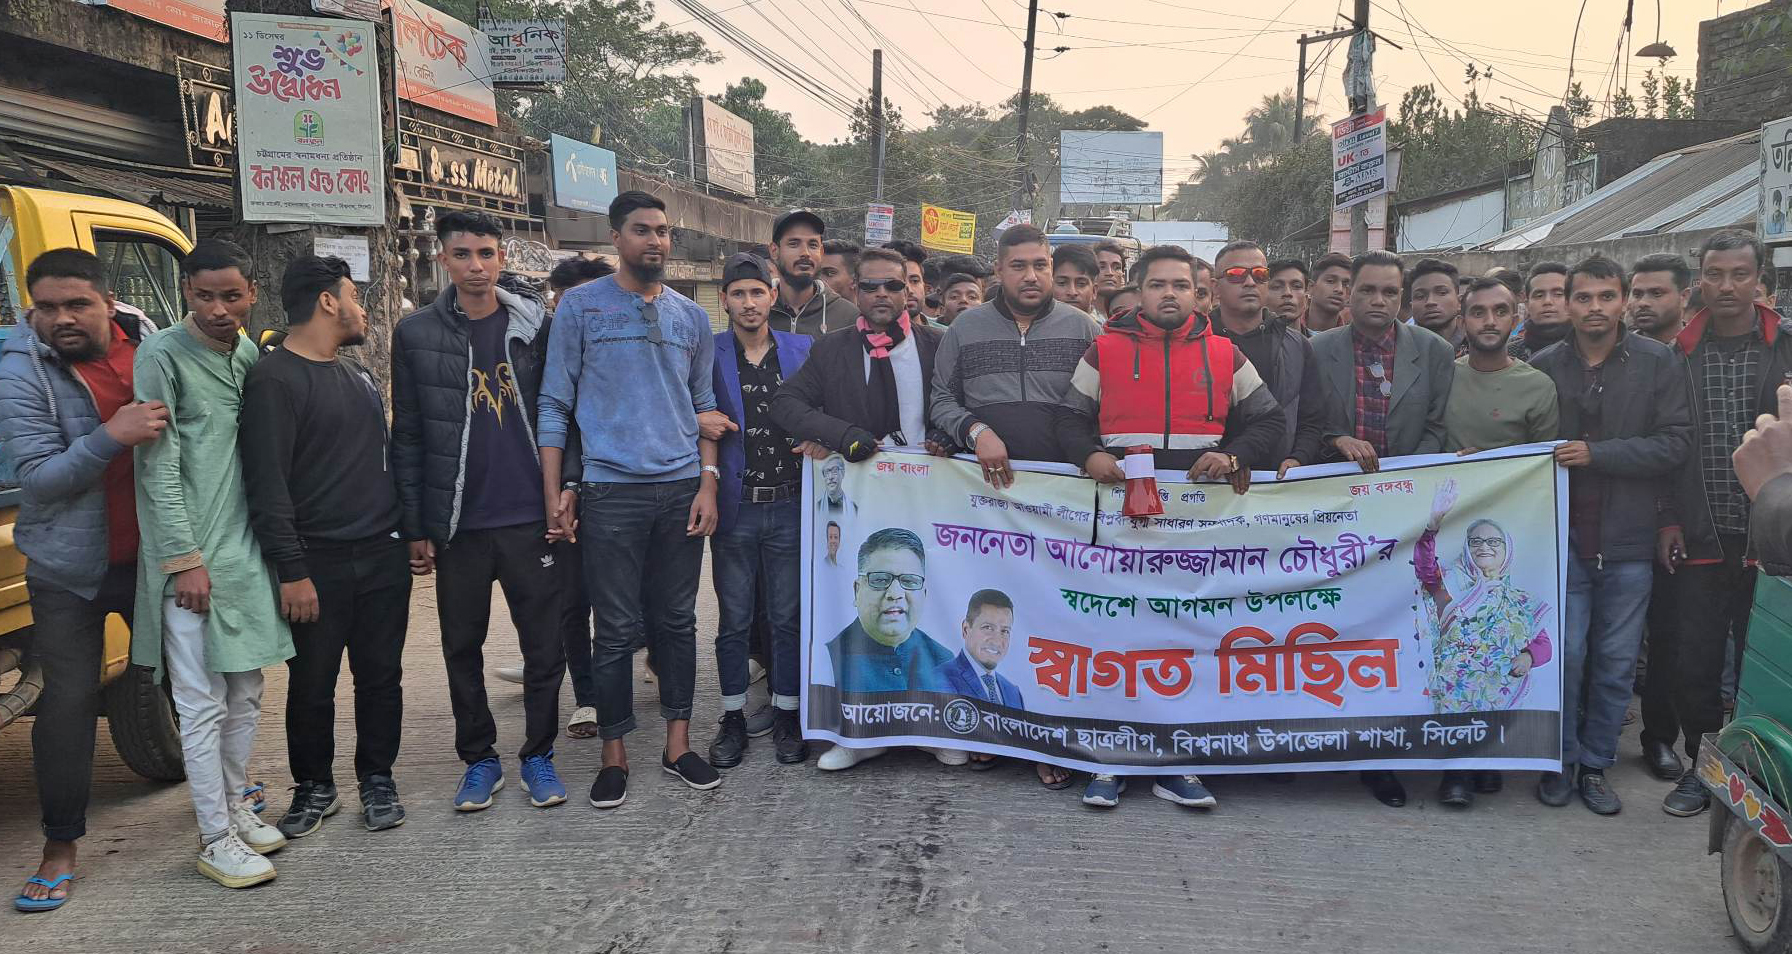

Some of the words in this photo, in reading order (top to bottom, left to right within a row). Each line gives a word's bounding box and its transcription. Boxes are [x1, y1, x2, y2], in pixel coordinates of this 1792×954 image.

[488, 26, 560, 47] আধুনিক
[272, 44, 326, 78] শুভ
[245, 64, 342, 103] উদ্বোধন
[1338, 152, 1355, 167] UK
[250, 164, 306, 192] বনফুল
[308, 167, 334, 194] এন্ড
[337, 168, 371, 194] কোং
[877, 461, 895, 473] জয়
[900, 463, 929, 477] বাংলা
[1181, 491, 1205, 504] প্রগতি
[1350, 484, 1370, 497] জয়
[1375, 479, 1413, 495] বঙ্গবন্ধু
[970, 494, 1009, 510] যুক্তরাজ্য
[1011, 502, 1054, 518] আওয়ামী
[1056, 505, 1091, 522] লীগের
[1154, 517, 1194, 530] সাধারণ
[1254, 512, 1309, 527] গণমানুষের
[1313, 510, 1359, 524] প্রিয়নেতা
[932, 522, 1035, 562] জননেতা
[1045, 537, 1270, 577] আনোয়ারুজ্জামান
[1060, 587, 1138, 618] স্বদেশে
[1147, 594, 1236, 620] আগমন
[1245, 587, 1342, 614] উপলক্ষে
[1028, 636, 1194, 698] স্বাগত
[1214, 622, 1400, 707] মিছিল
[982, 711, 1068, 747] বাংলাদেশ
[1076, 724, 1165, 758] ছাত্রলীগ,
[1171, 729, 1249, 756] বিশ্বনাথ
[1257, 724, 1350, 752] উপজেলা
[1356, 726, 1413, 751] শাখা,
[1421, 718, 1490, 746] সিলেট
